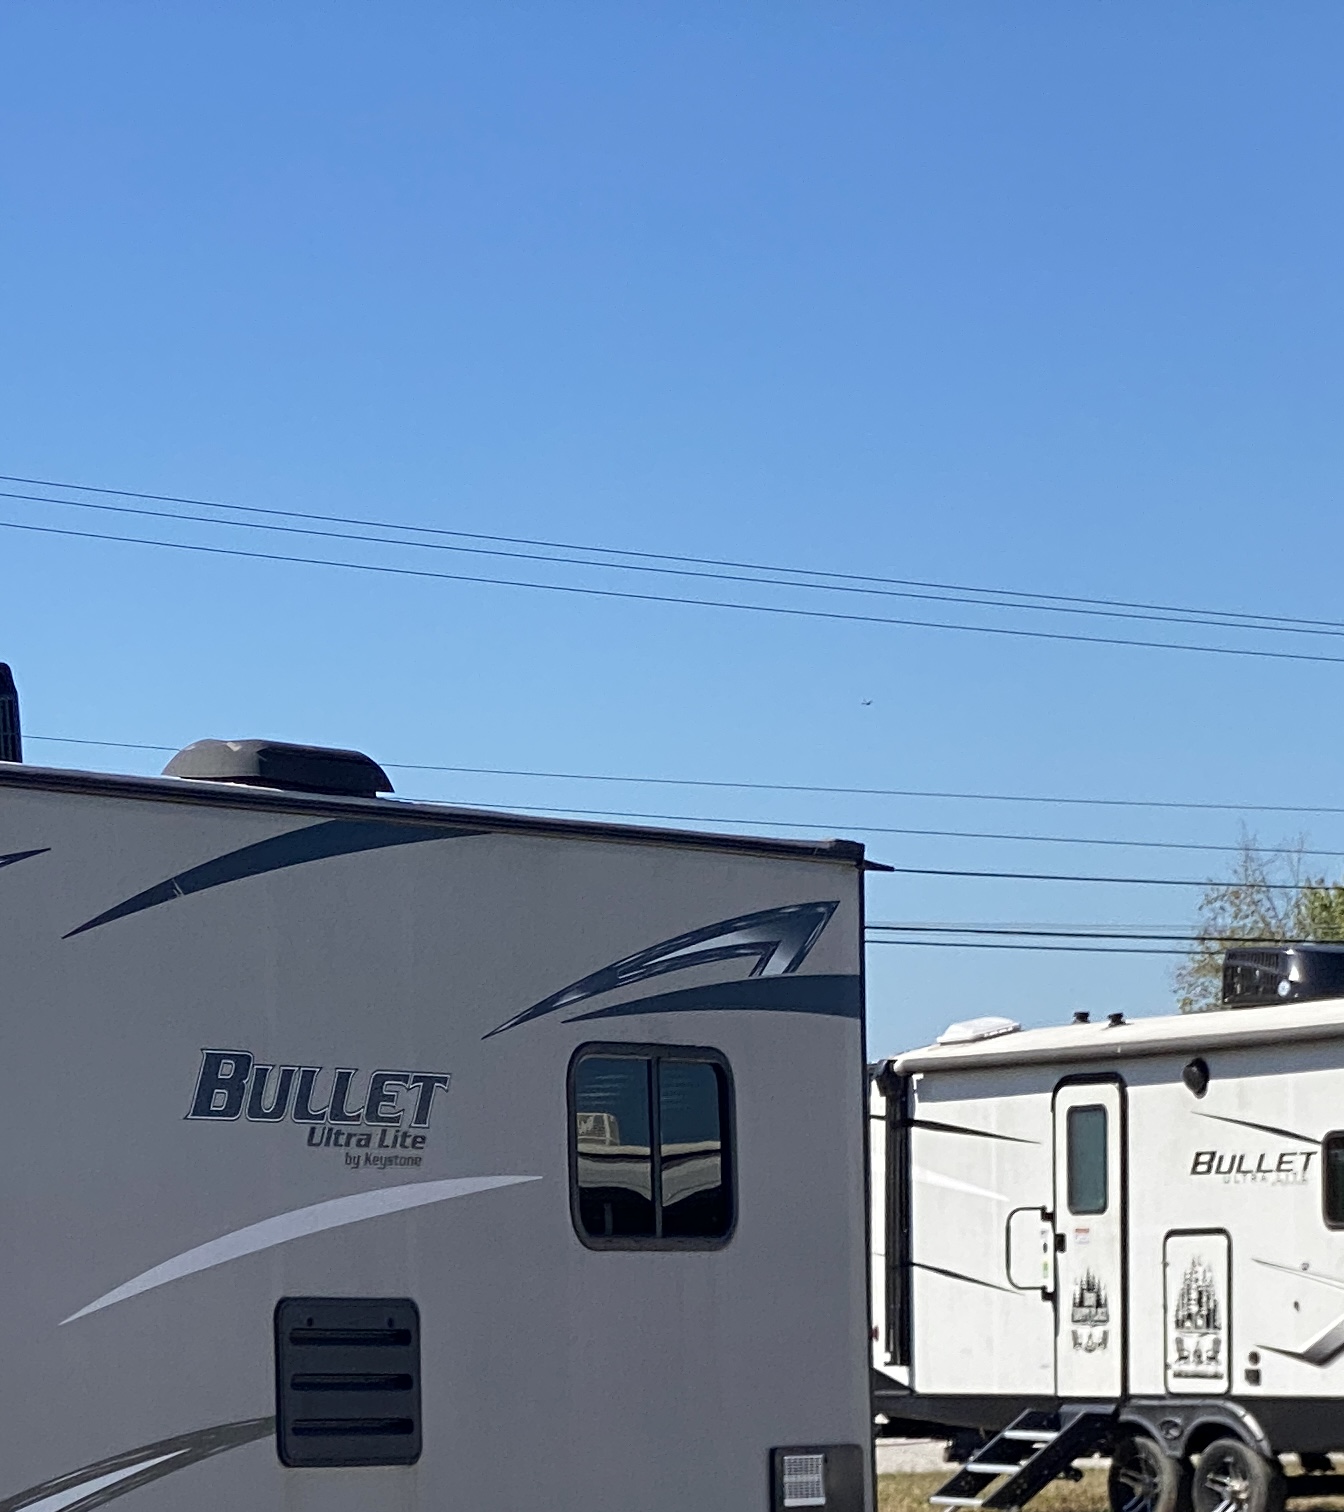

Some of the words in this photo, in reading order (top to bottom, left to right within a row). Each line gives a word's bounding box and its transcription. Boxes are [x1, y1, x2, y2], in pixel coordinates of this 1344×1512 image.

[183, 1049, 451, 1129] BULLET
[307, 1126, 372, 1148] Ultra
[378, 1127, 427, 1150] Lite
[345, 1152, 361, 1170] by
[364, 1152, 422, 1170] Keystone
[1190, 1151, 1318, 1176] BULLET
